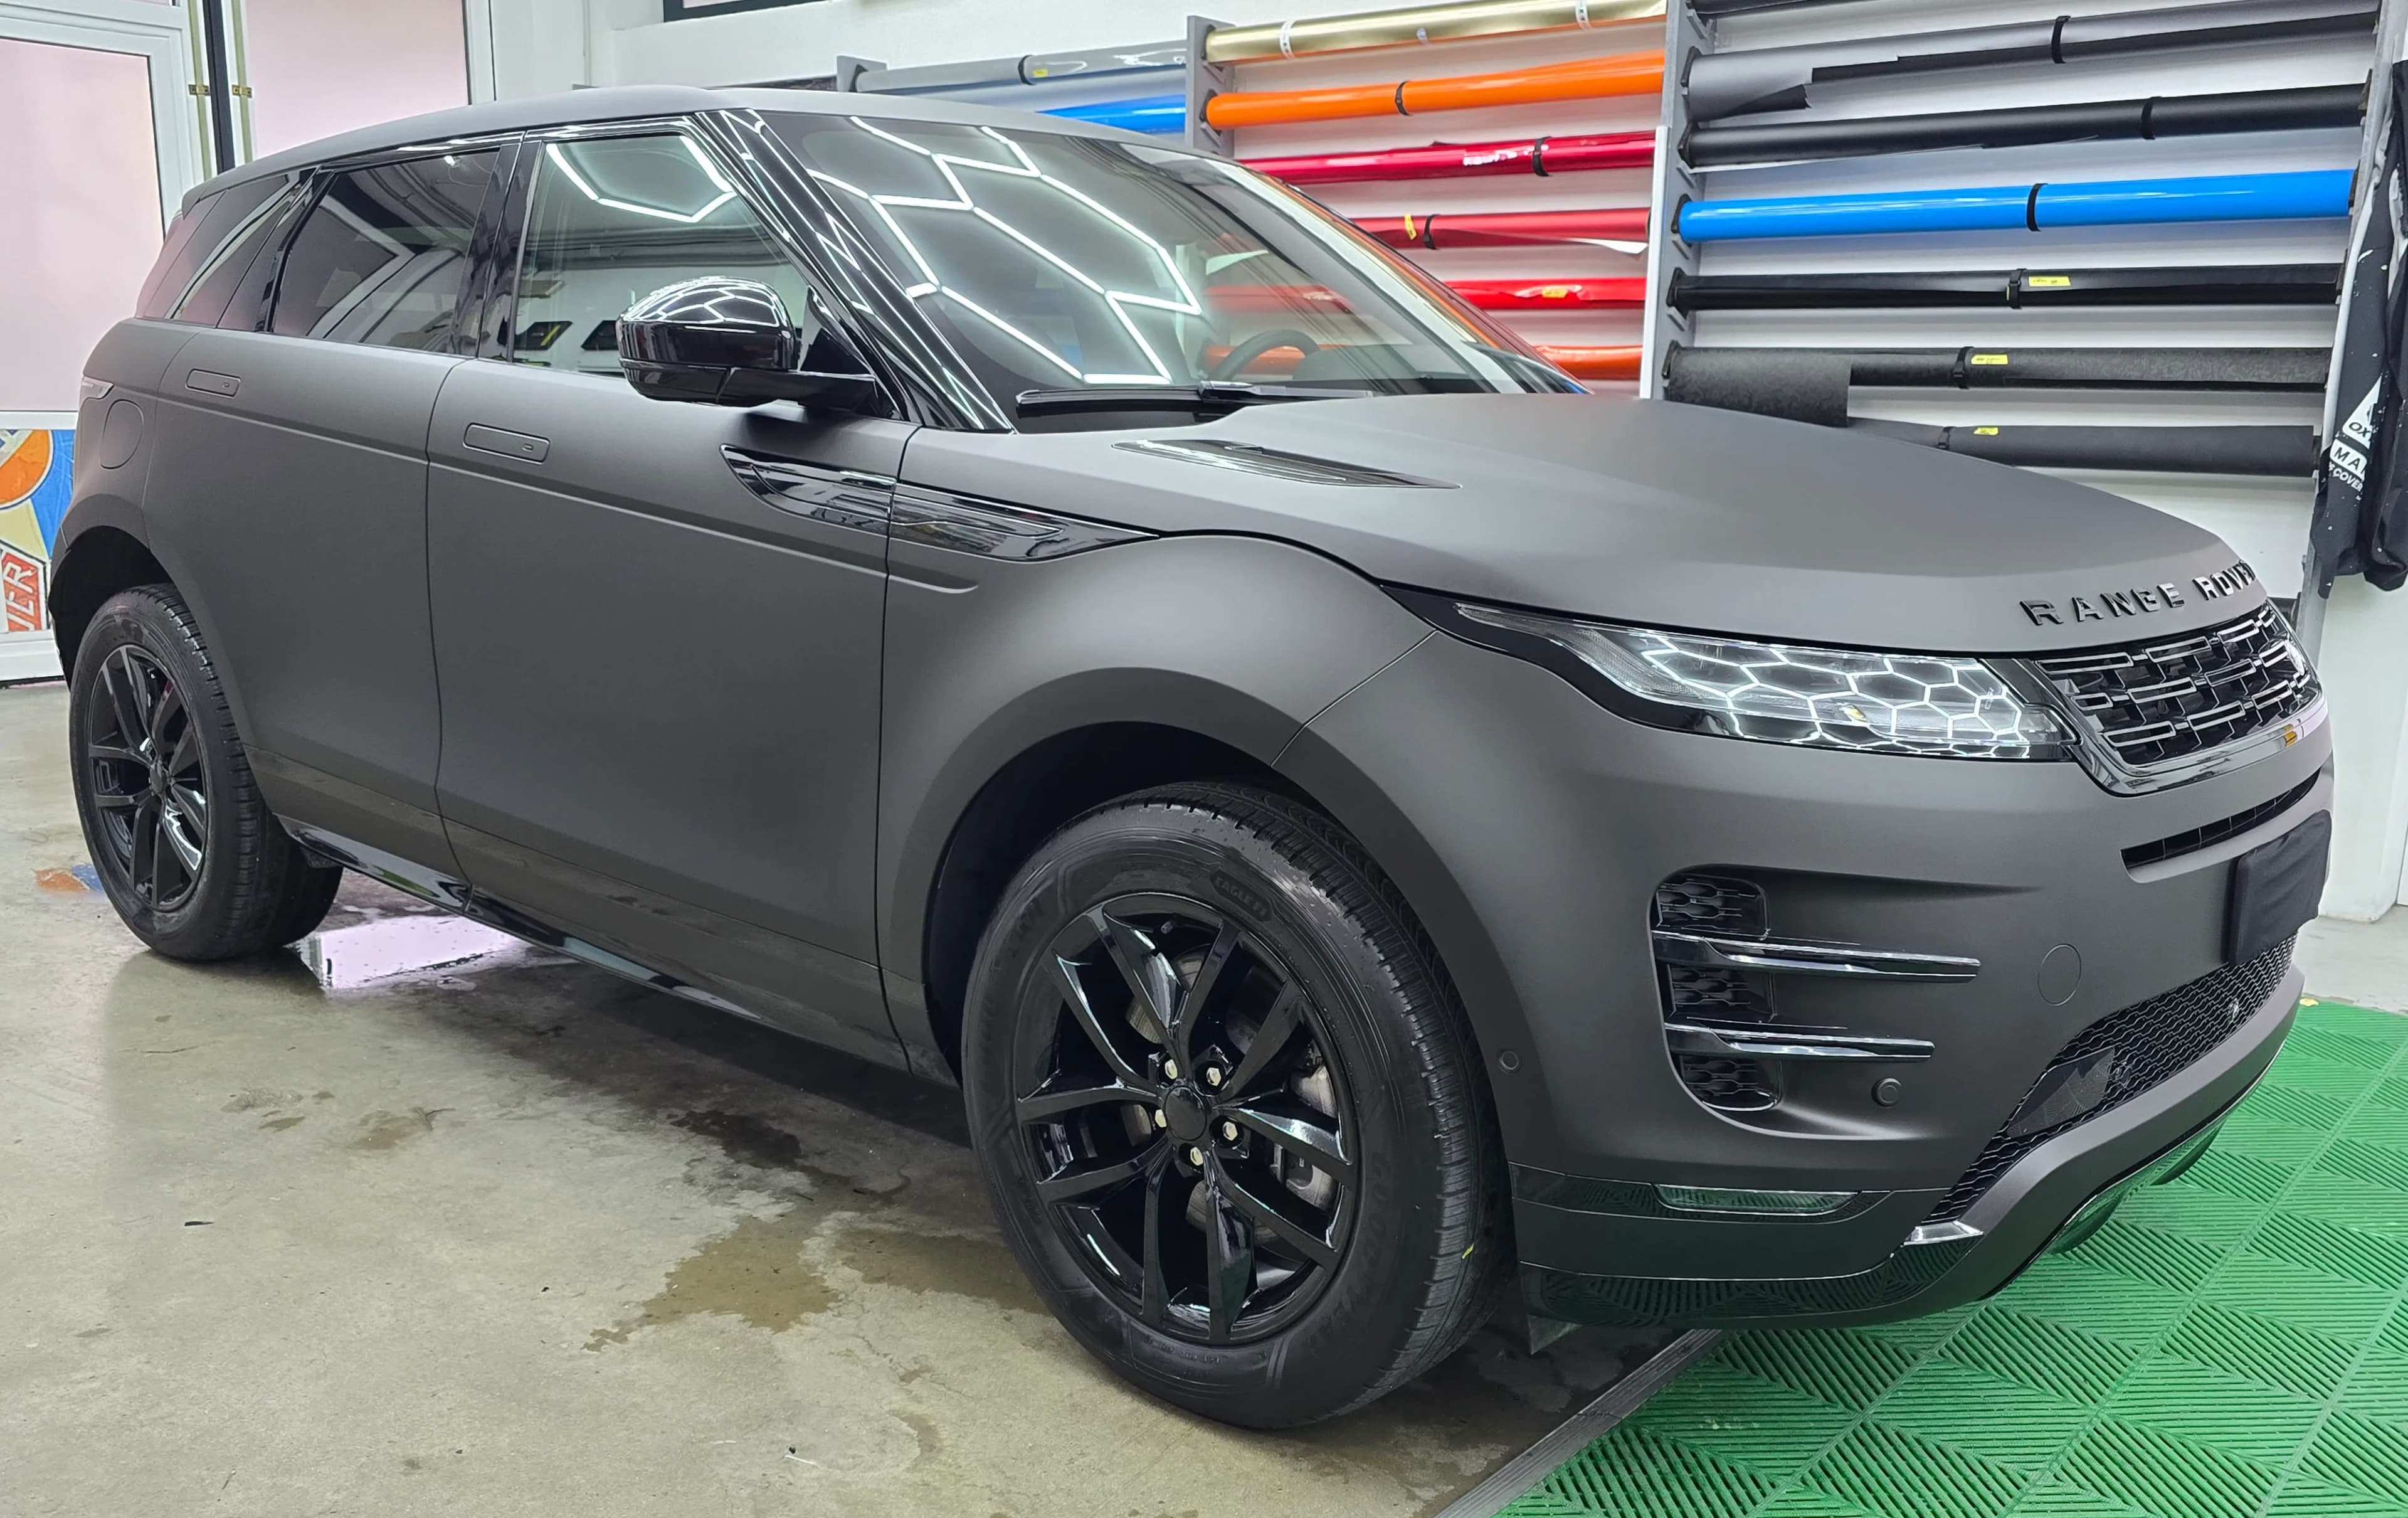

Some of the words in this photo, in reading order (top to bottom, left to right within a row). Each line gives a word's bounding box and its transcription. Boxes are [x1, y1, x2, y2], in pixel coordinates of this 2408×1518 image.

[2348, 422, 2372, 442] OX
[2333, 446, 2368, 474] MA
[2019, 582, 2185, 626] RANGE
[1214, 876, 1254, 905] EAGLE
